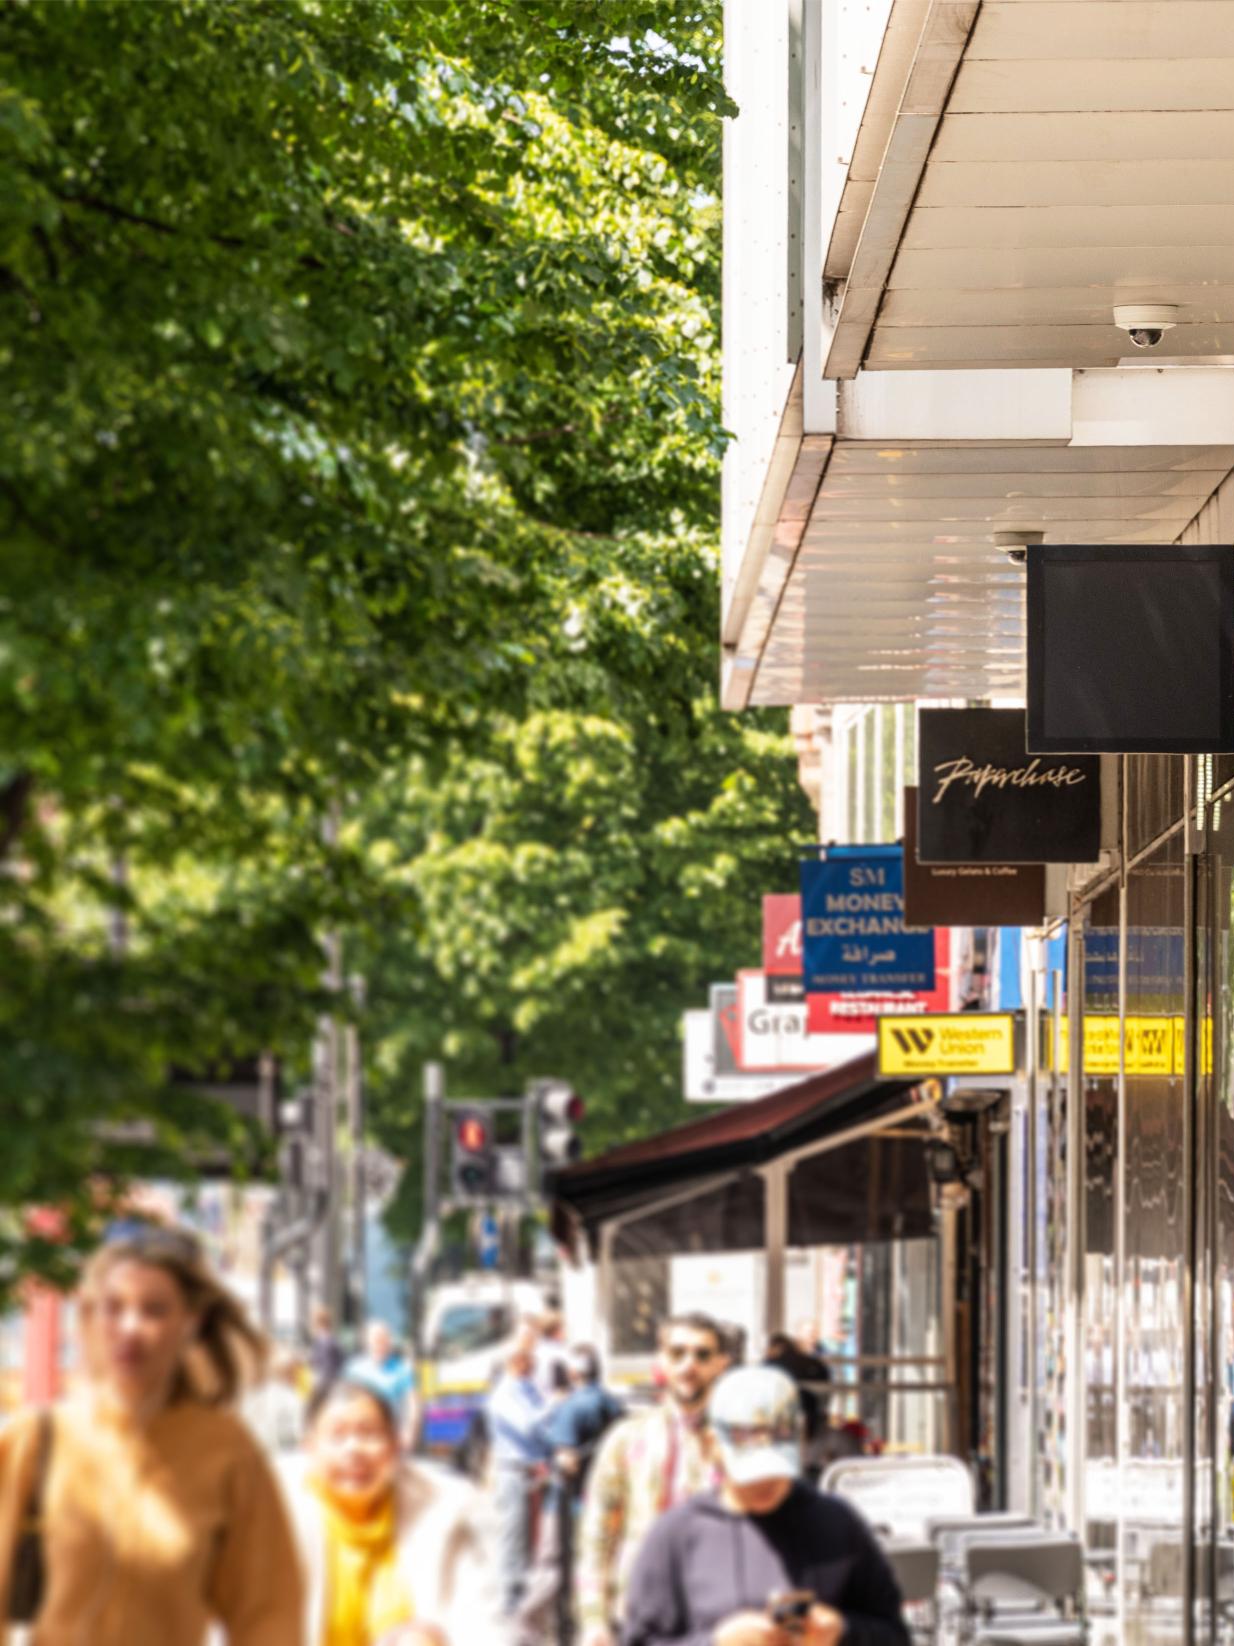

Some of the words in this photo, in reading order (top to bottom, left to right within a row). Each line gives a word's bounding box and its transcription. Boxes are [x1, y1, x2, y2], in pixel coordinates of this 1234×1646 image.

[848, 867, 886, 888] SM
[940, 1027, 1003, 1041] Western
[940, 1041, 985, 1055] Union
